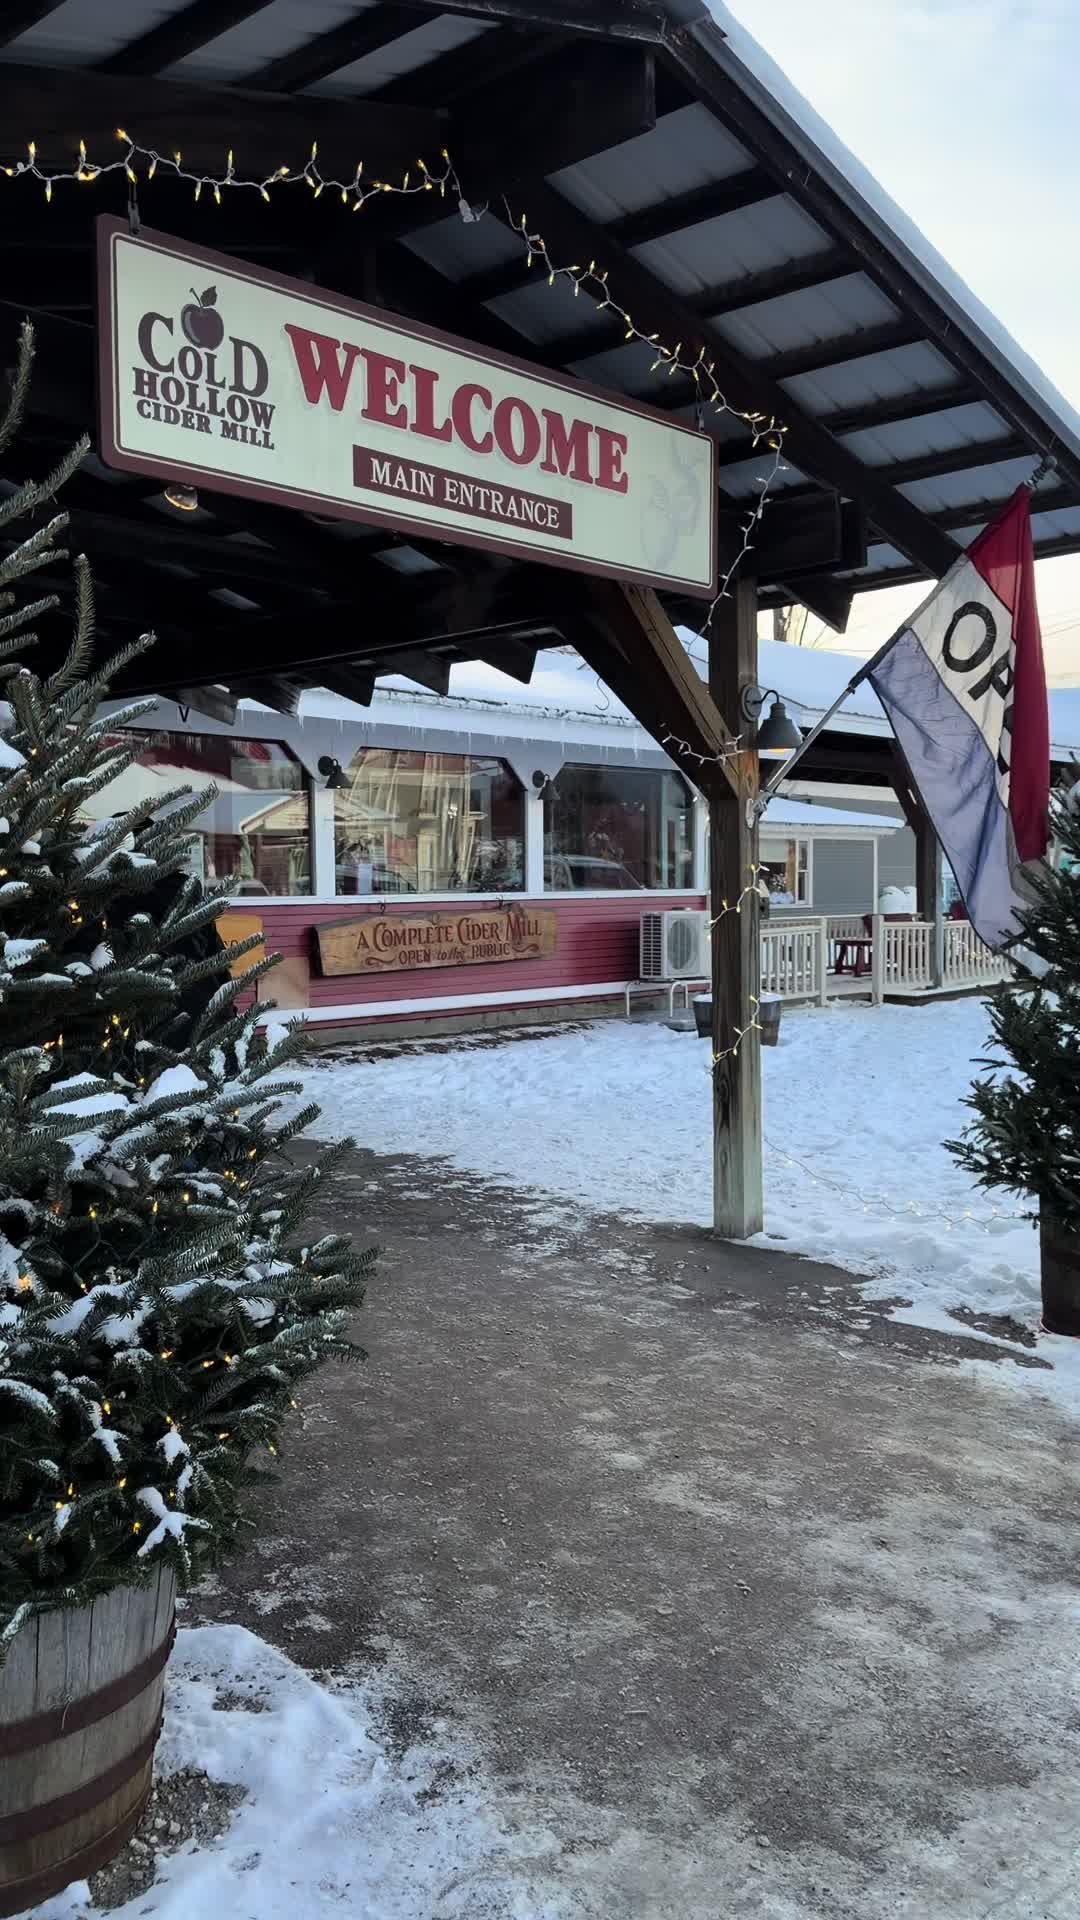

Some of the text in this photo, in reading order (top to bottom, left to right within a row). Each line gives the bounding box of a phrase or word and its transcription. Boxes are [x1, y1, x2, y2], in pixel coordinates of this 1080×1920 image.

[138, 312, 268, 397] COLD
[132, 368, 276, 430] HOLLOW
[136, 402, 275, 450] CIDER MILL
[284, 324, 628, 494] WELCOME
[370, 458, 560, 528] MAIN ENTRANCE
[357, 913, 542, 952] A COMPLETE CIDER MILL
[399, 949, 431, 964] OPEN
[472, 943, 510, 959] PUBLIC
